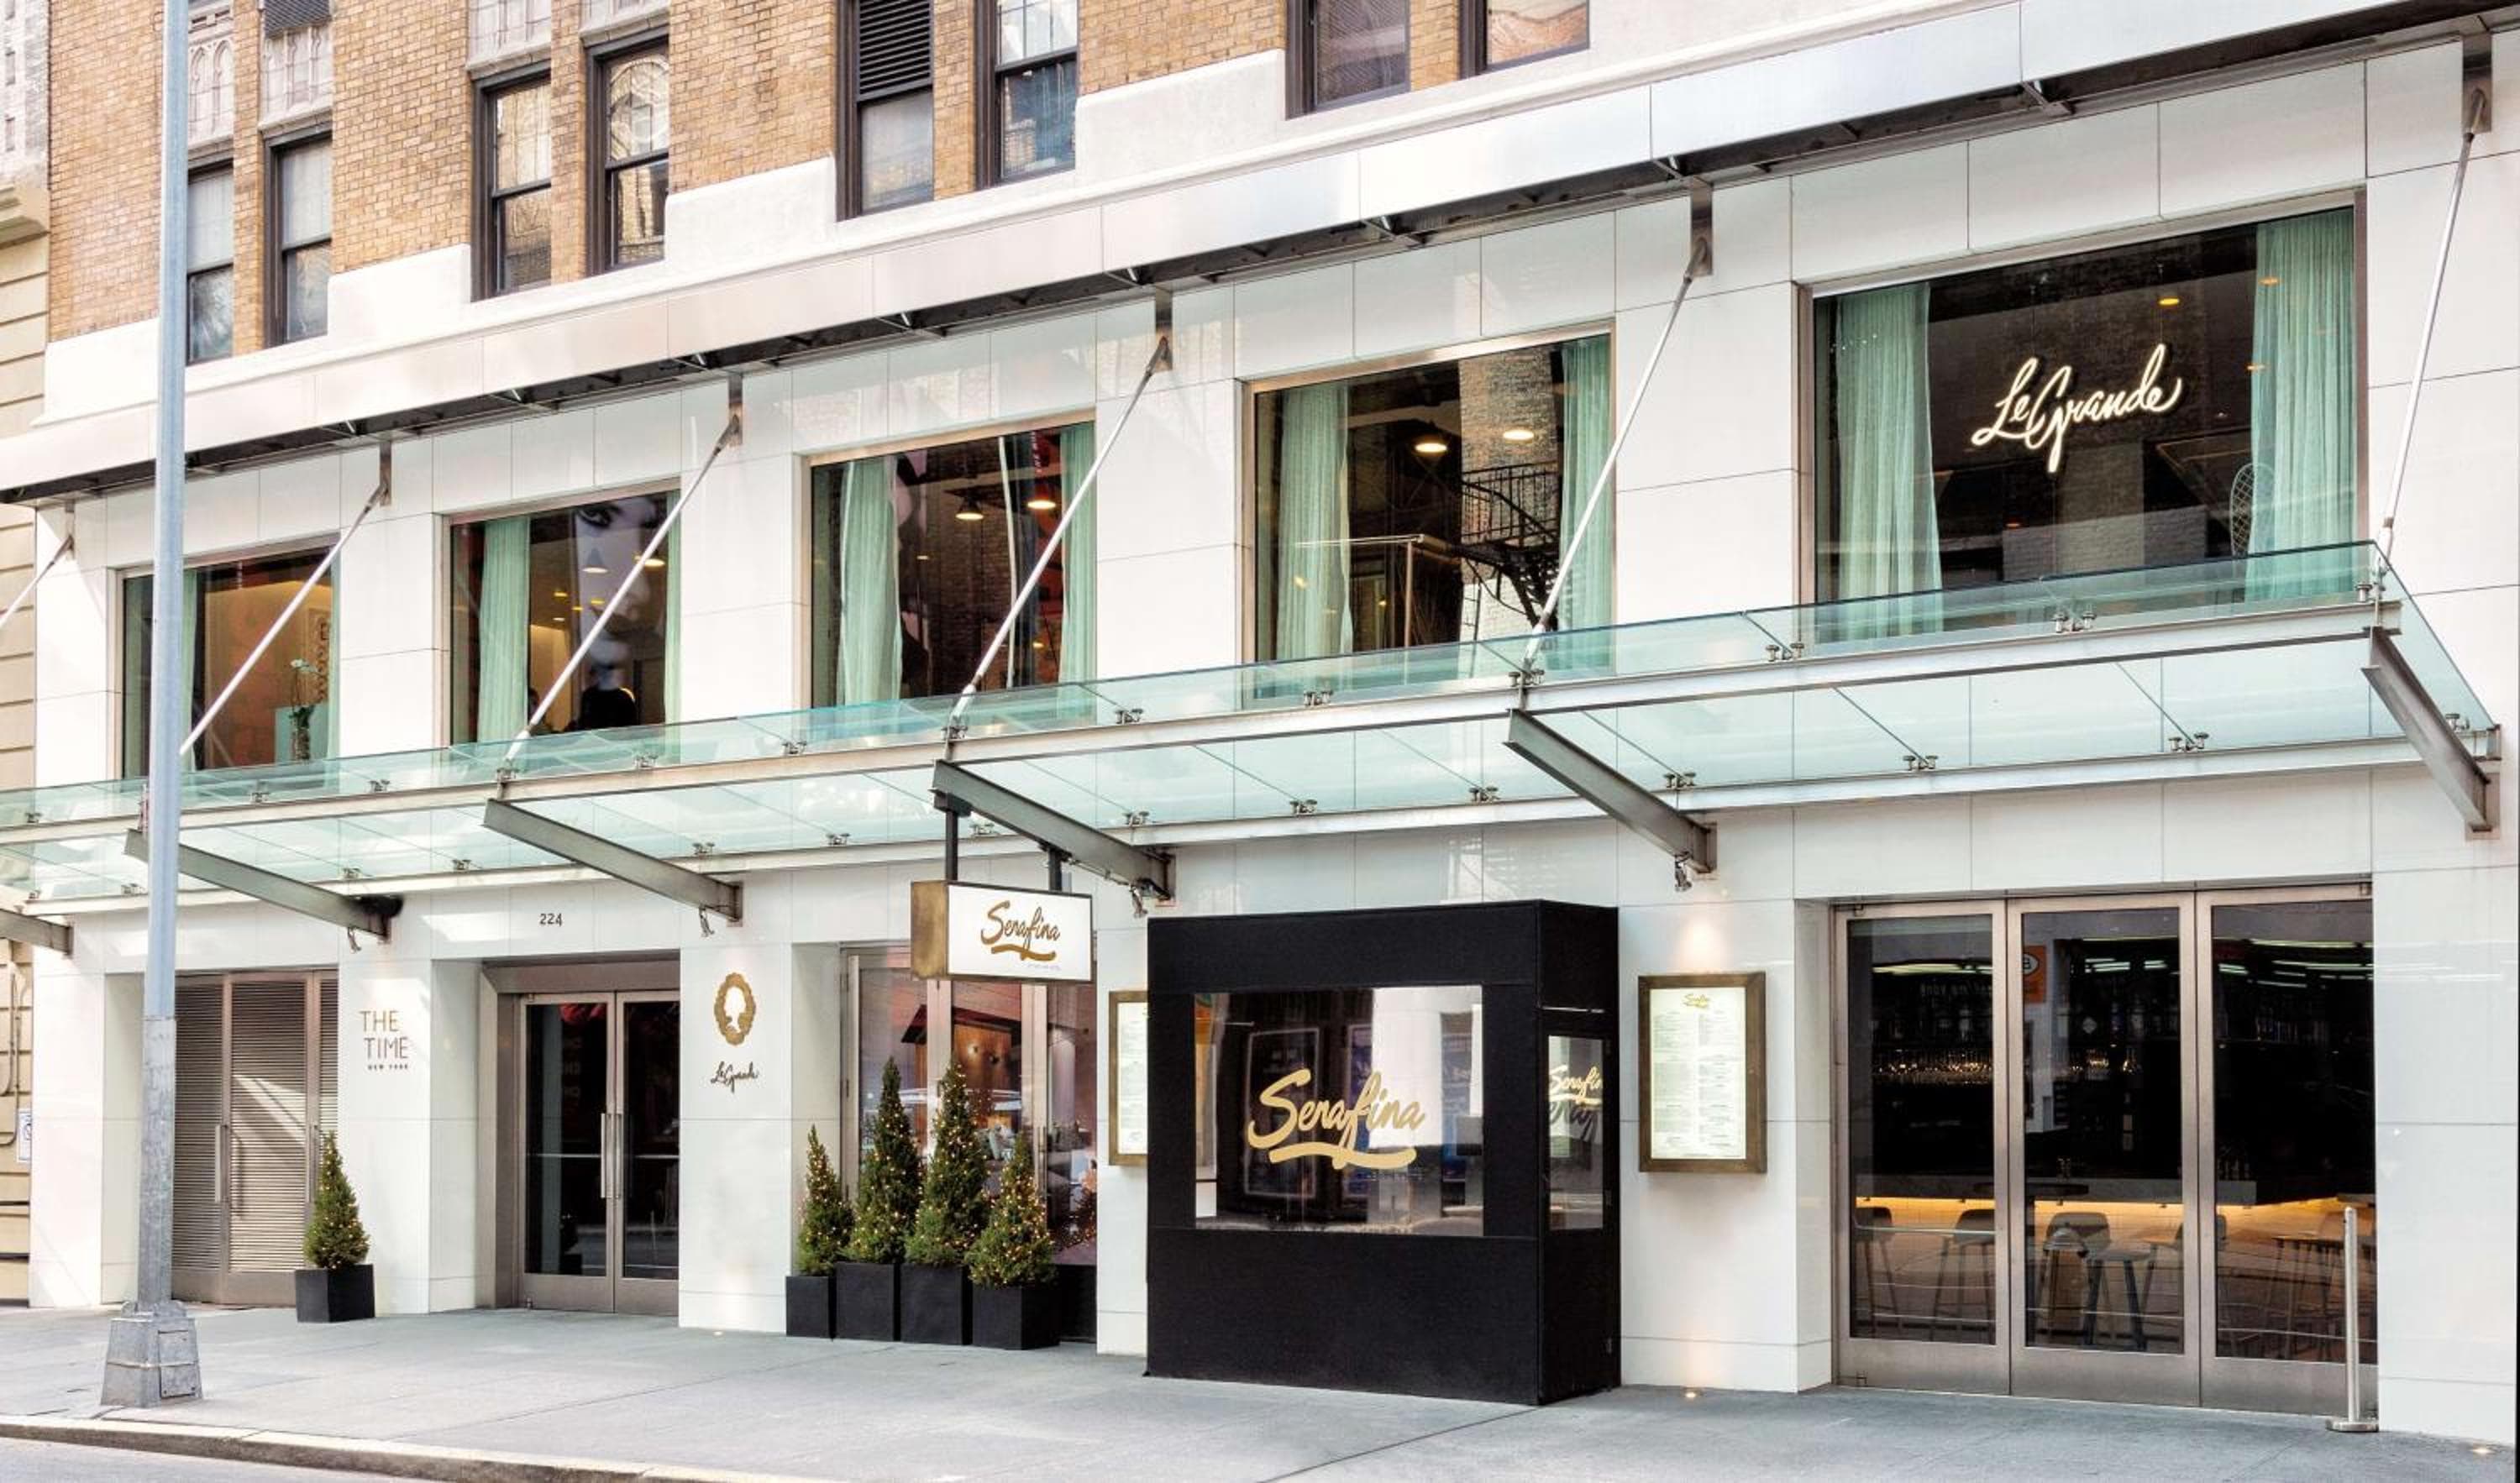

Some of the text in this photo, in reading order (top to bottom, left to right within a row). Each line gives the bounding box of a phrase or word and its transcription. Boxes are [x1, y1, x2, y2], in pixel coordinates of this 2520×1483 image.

[539, 913, 562, 927] 224
[980, 900, 1060, 961] Serafina
[359, 1010, 399, 1032] THE
[364, 1036, 408, 1059] TIME
[1247, 1068, 1425, 1170] Serafina
